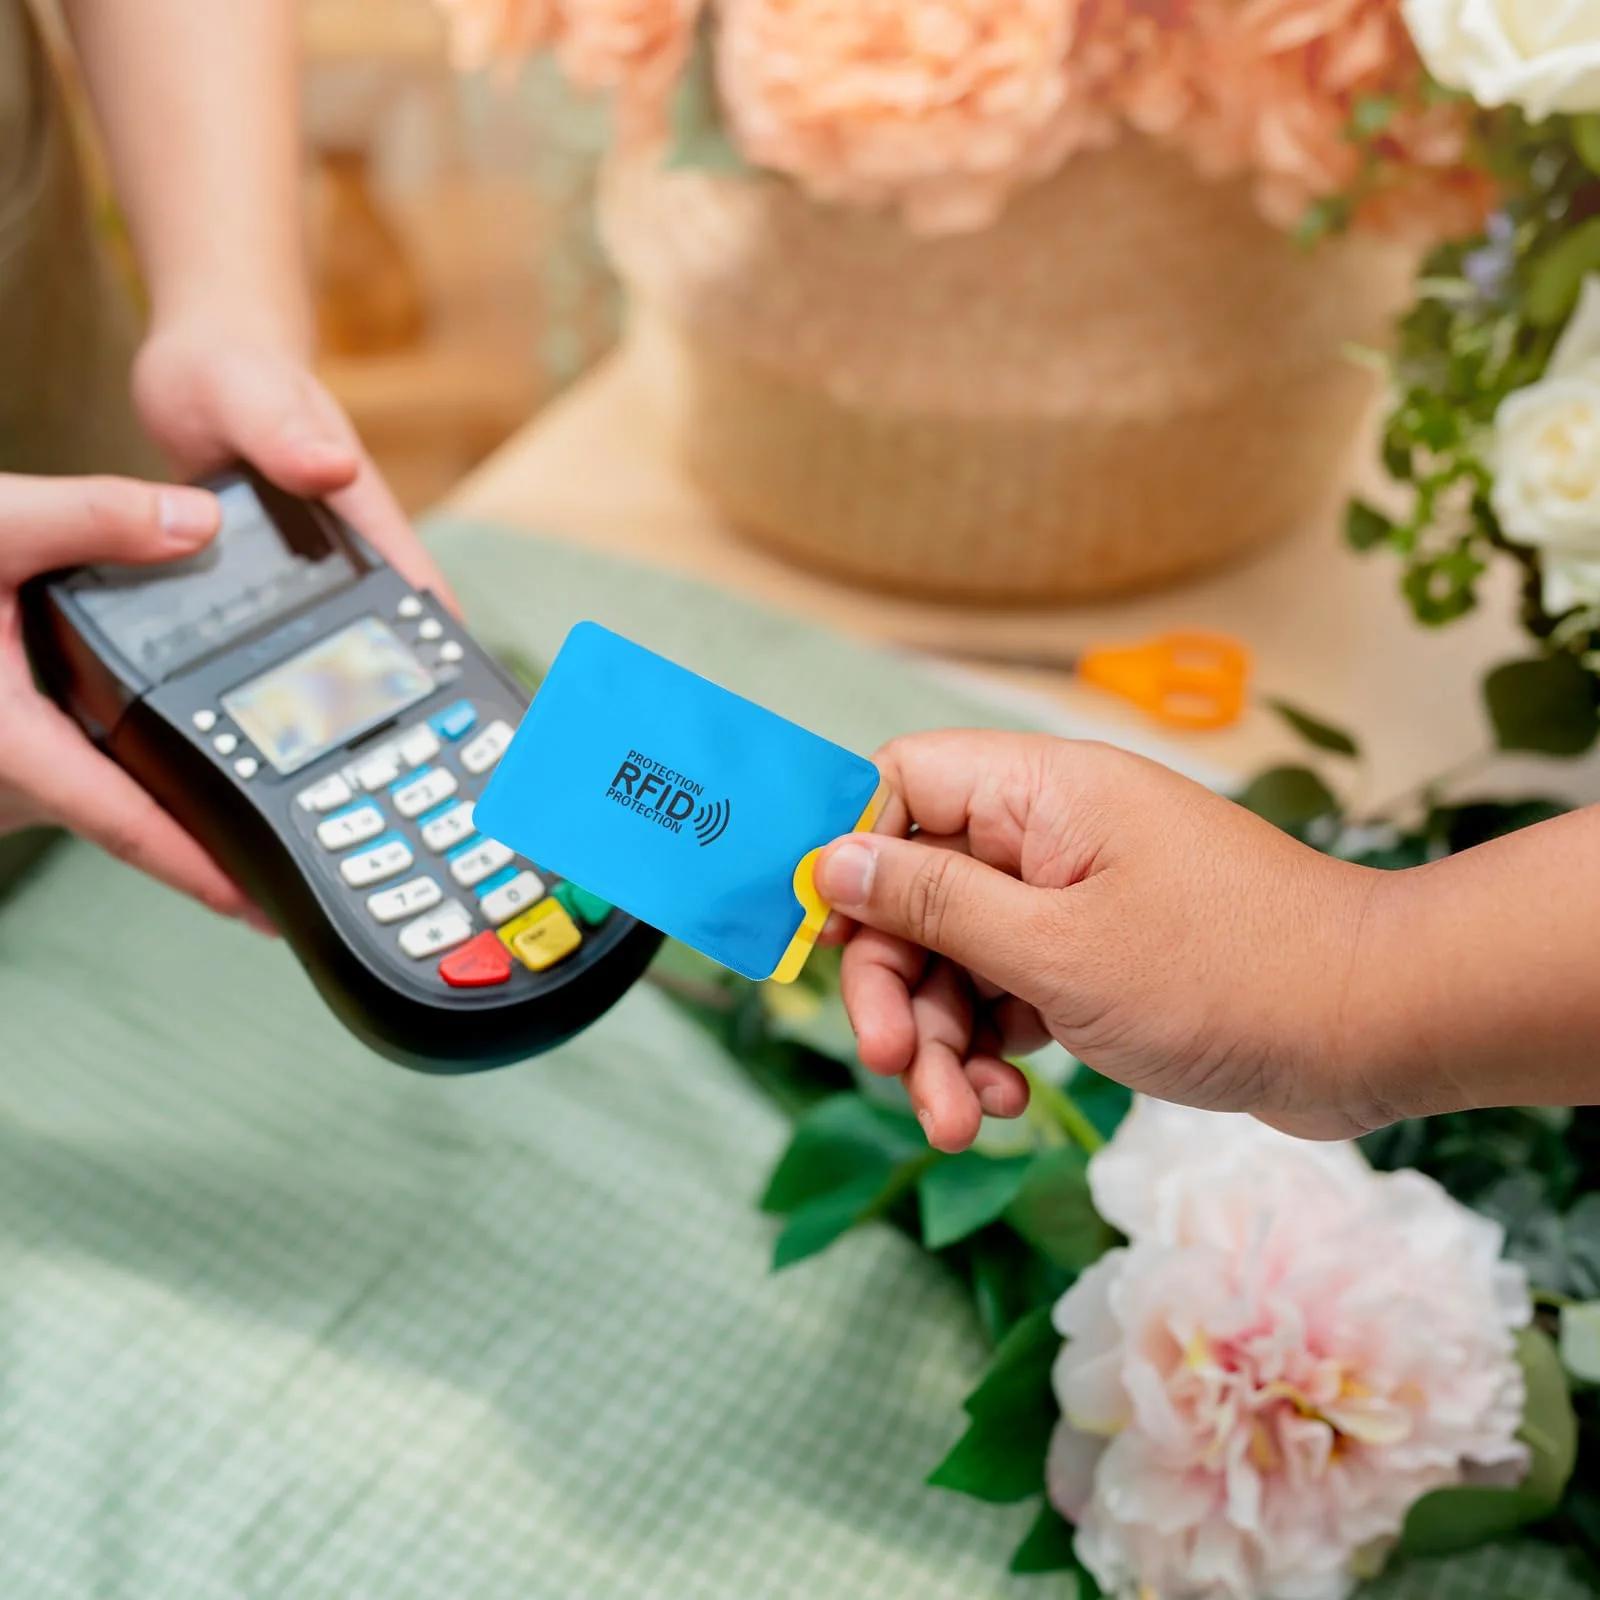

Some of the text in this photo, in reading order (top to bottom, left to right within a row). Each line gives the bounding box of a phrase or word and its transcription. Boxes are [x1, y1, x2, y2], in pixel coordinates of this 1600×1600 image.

[611, 760, 695, 821] RFID
[626, 749, 705, 796] PROTECTION
[605, 787, 682, 834] PROTECTION
